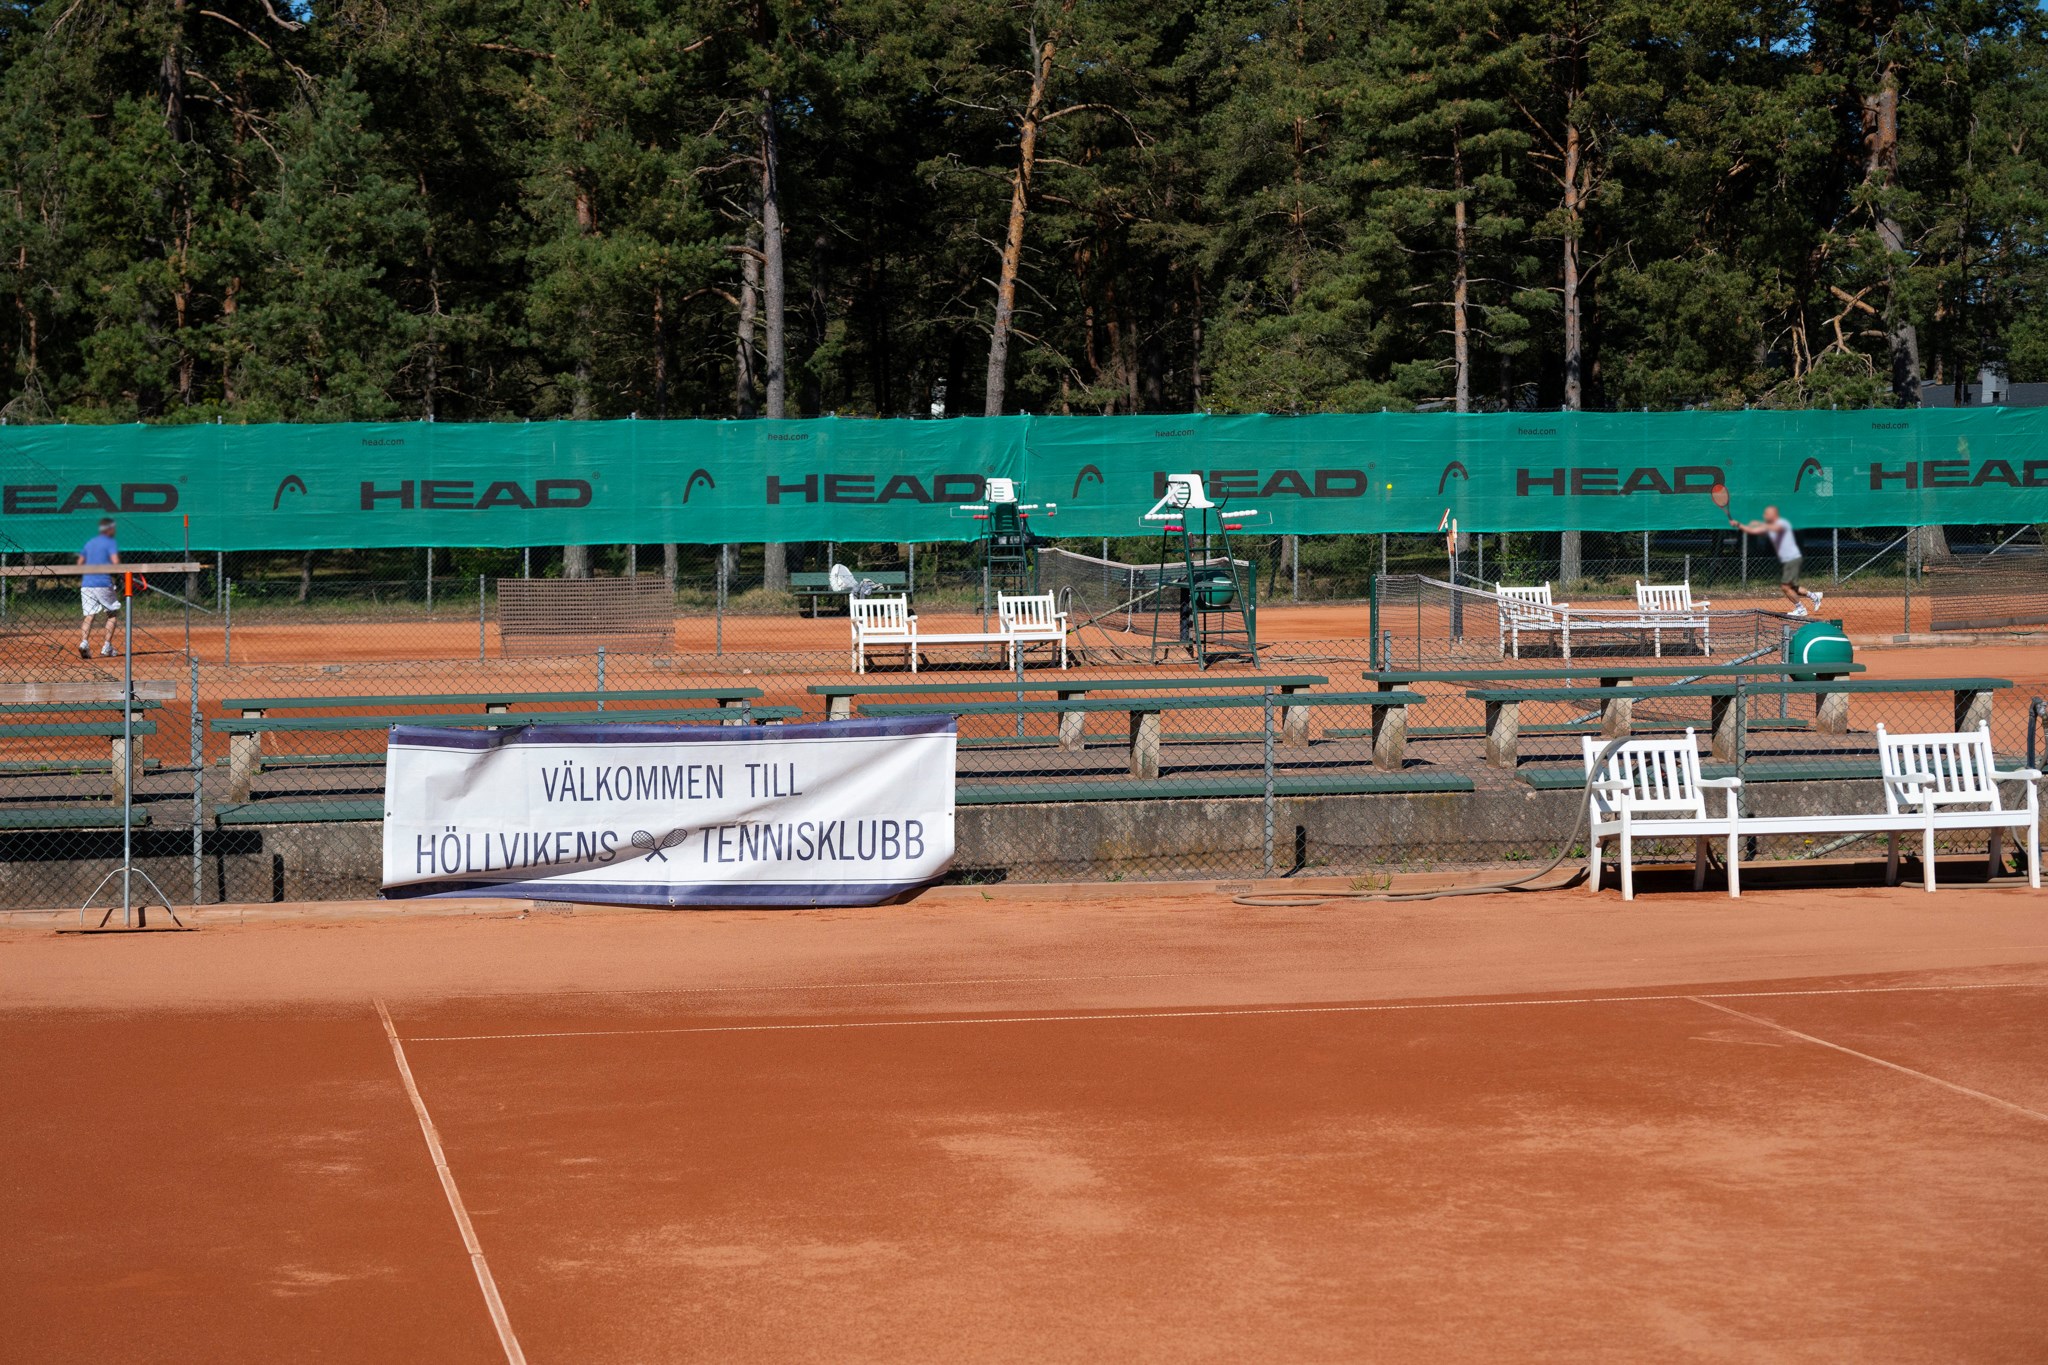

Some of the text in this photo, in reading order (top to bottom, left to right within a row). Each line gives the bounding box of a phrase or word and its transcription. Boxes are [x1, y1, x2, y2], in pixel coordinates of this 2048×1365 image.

[767, 432, 809, 442] head.com
[1155, 428, 1195, 438] head.com
[1518, 426, 1557, 436] head.com
[1871, 421, 1910, 431] head.com
[361, 437, 405, 447] head.com
[361, 479, 593, 511] HEAD
[767, 473, 985, 505] HEAD
[1516, 465, 1727, 496] HEAD
[2, 483, 179, 515] EAD
[541, 760, 803, 802] VÄLKOMMEN TILL
[416, 819, 925, 874] HÖLLVIKENS TENNISKLUBB
